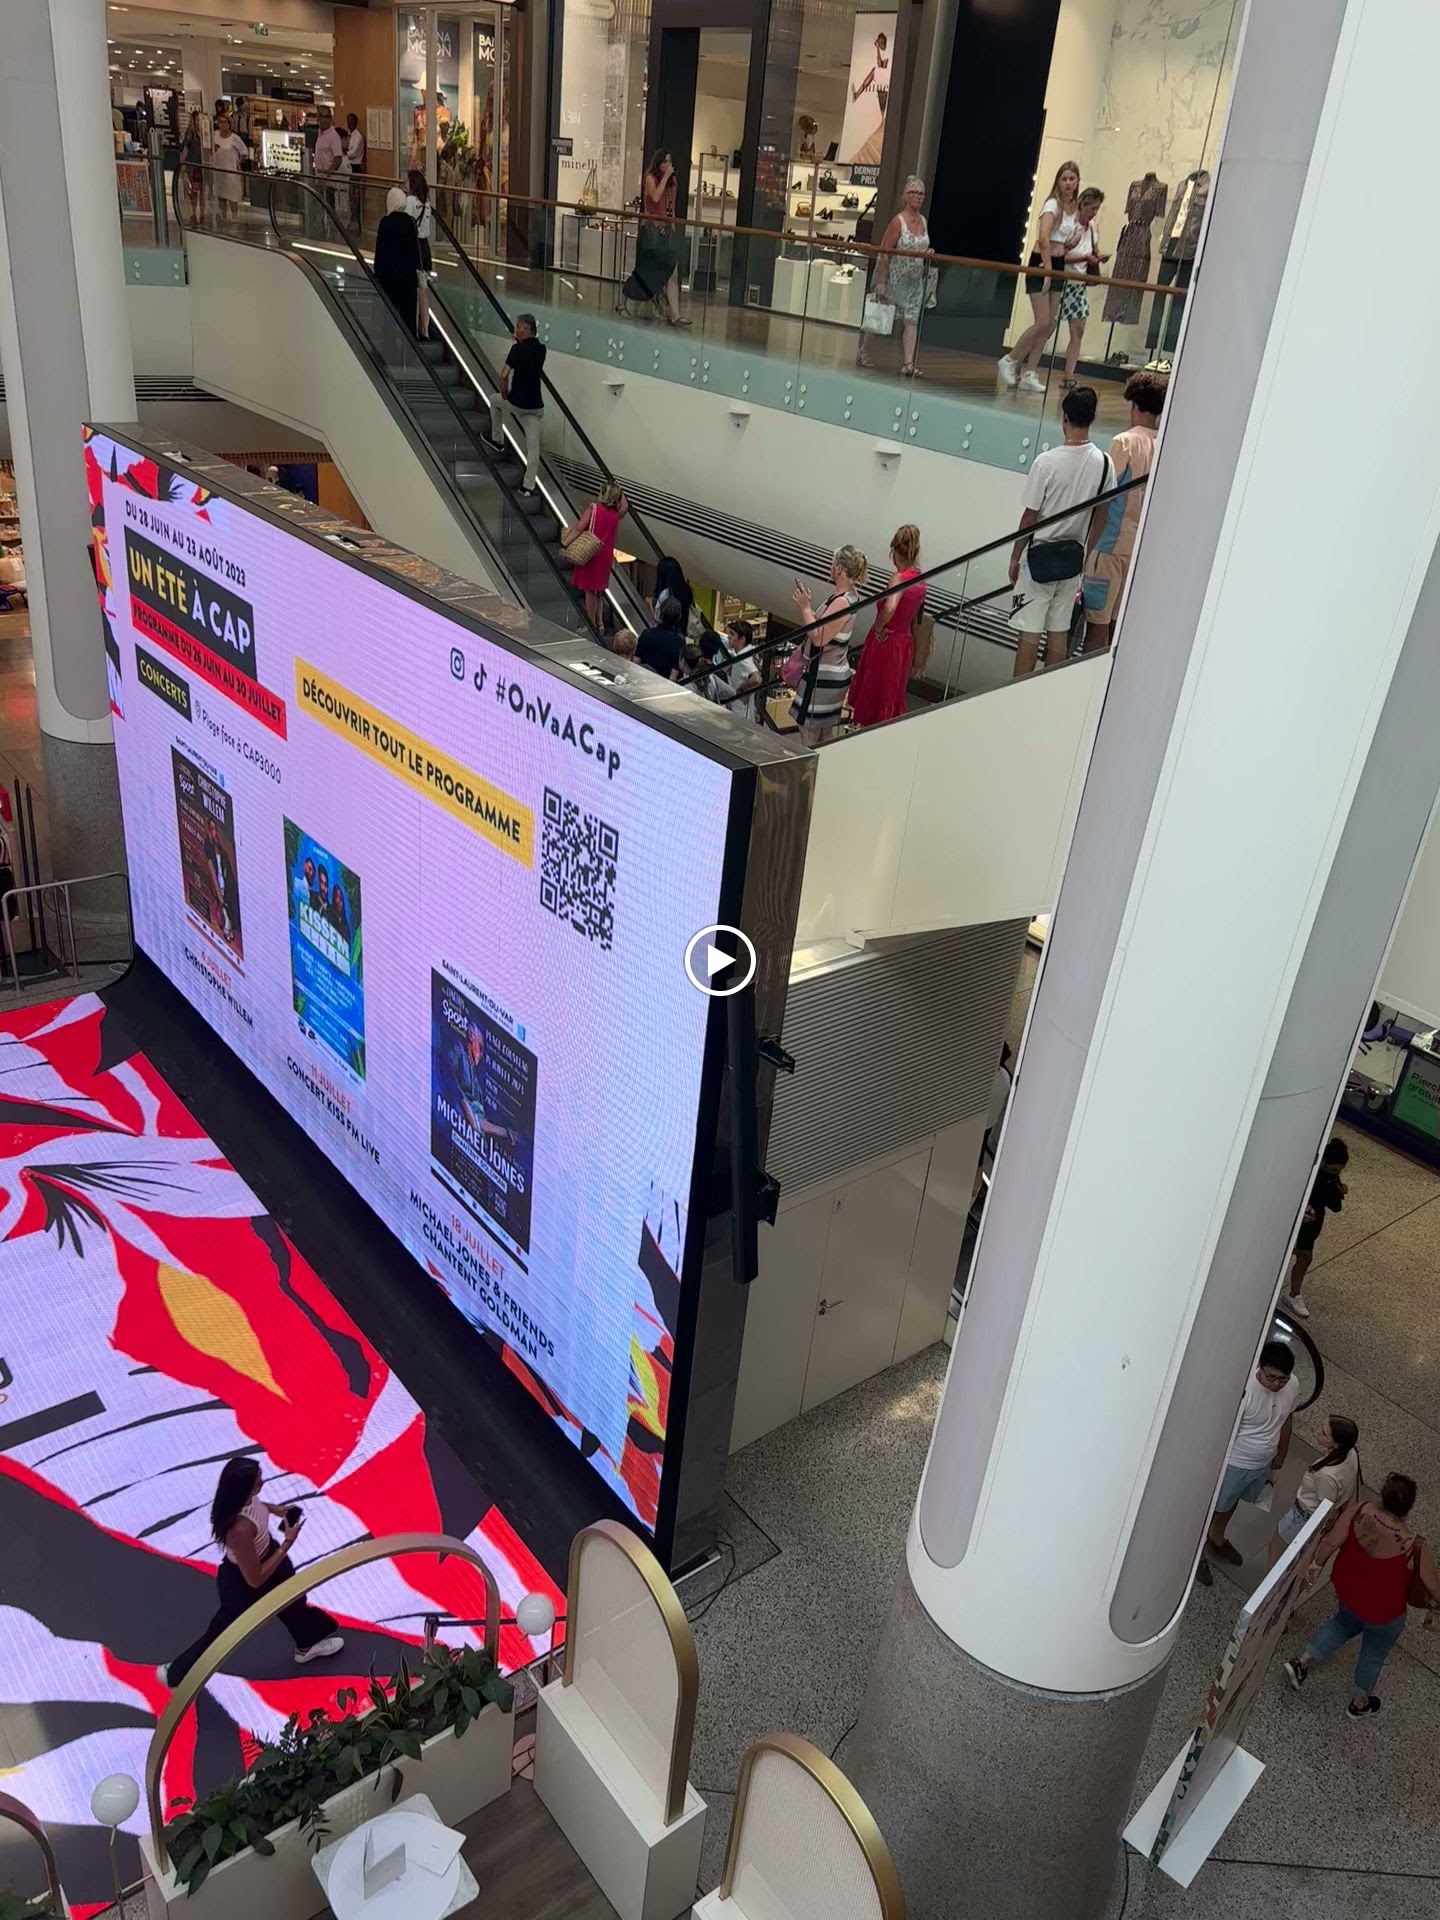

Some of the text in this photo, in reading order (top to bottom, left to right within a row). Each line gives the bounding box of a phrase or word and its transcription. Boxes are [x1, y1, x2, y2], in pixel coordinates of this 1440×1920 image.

[860, 175, 877, 185] PRIX
[125, 499, 246, 588] DU 28 JUIN AU 23 AOÛT 2023
[129, 546, 251, 654] UN ÉTÉ À CAP
[140, 659, 188, 709] CONCERTS
[180, 636, 192, 657] DU
[202, 652, 221, 679] JUIN
[223, 669, 235, 690] AU
[248, 687, 282, 724] JUILLET
[202, 709, 220, 738] Plage
[221, 723, 235, 748] face
[242, 743, 282, 785] CAP3000
[302, 676, 521, 844] DÉCOUVRIR TOUT LE PROGRAMME
[496, 675, 622, 780] #OnVaACap
[184, 946, 255, 1031] CHRISTOPHE WILLEM
[287, 1055, 381, 1166] CONCERT KISS FM LIVE
[437, 1094, 487, 1158] MICHAEL
[489, 1137, 525, 1194] JONES
[410, 1188, 455, 1247] MICHAEL
[456, 1242, 491, 1287] JONES
[493, 1281, 501, 1298] &
[503, 1291, 555, 1358] FRIENDS
[422, 1223, 478, 1293] CHANTENT
[479, 1287, 539, 1361] GOLDMAN
[451, 1214, 462, 1233] 18
[463, 1230, 506, 1281] JUILLET
